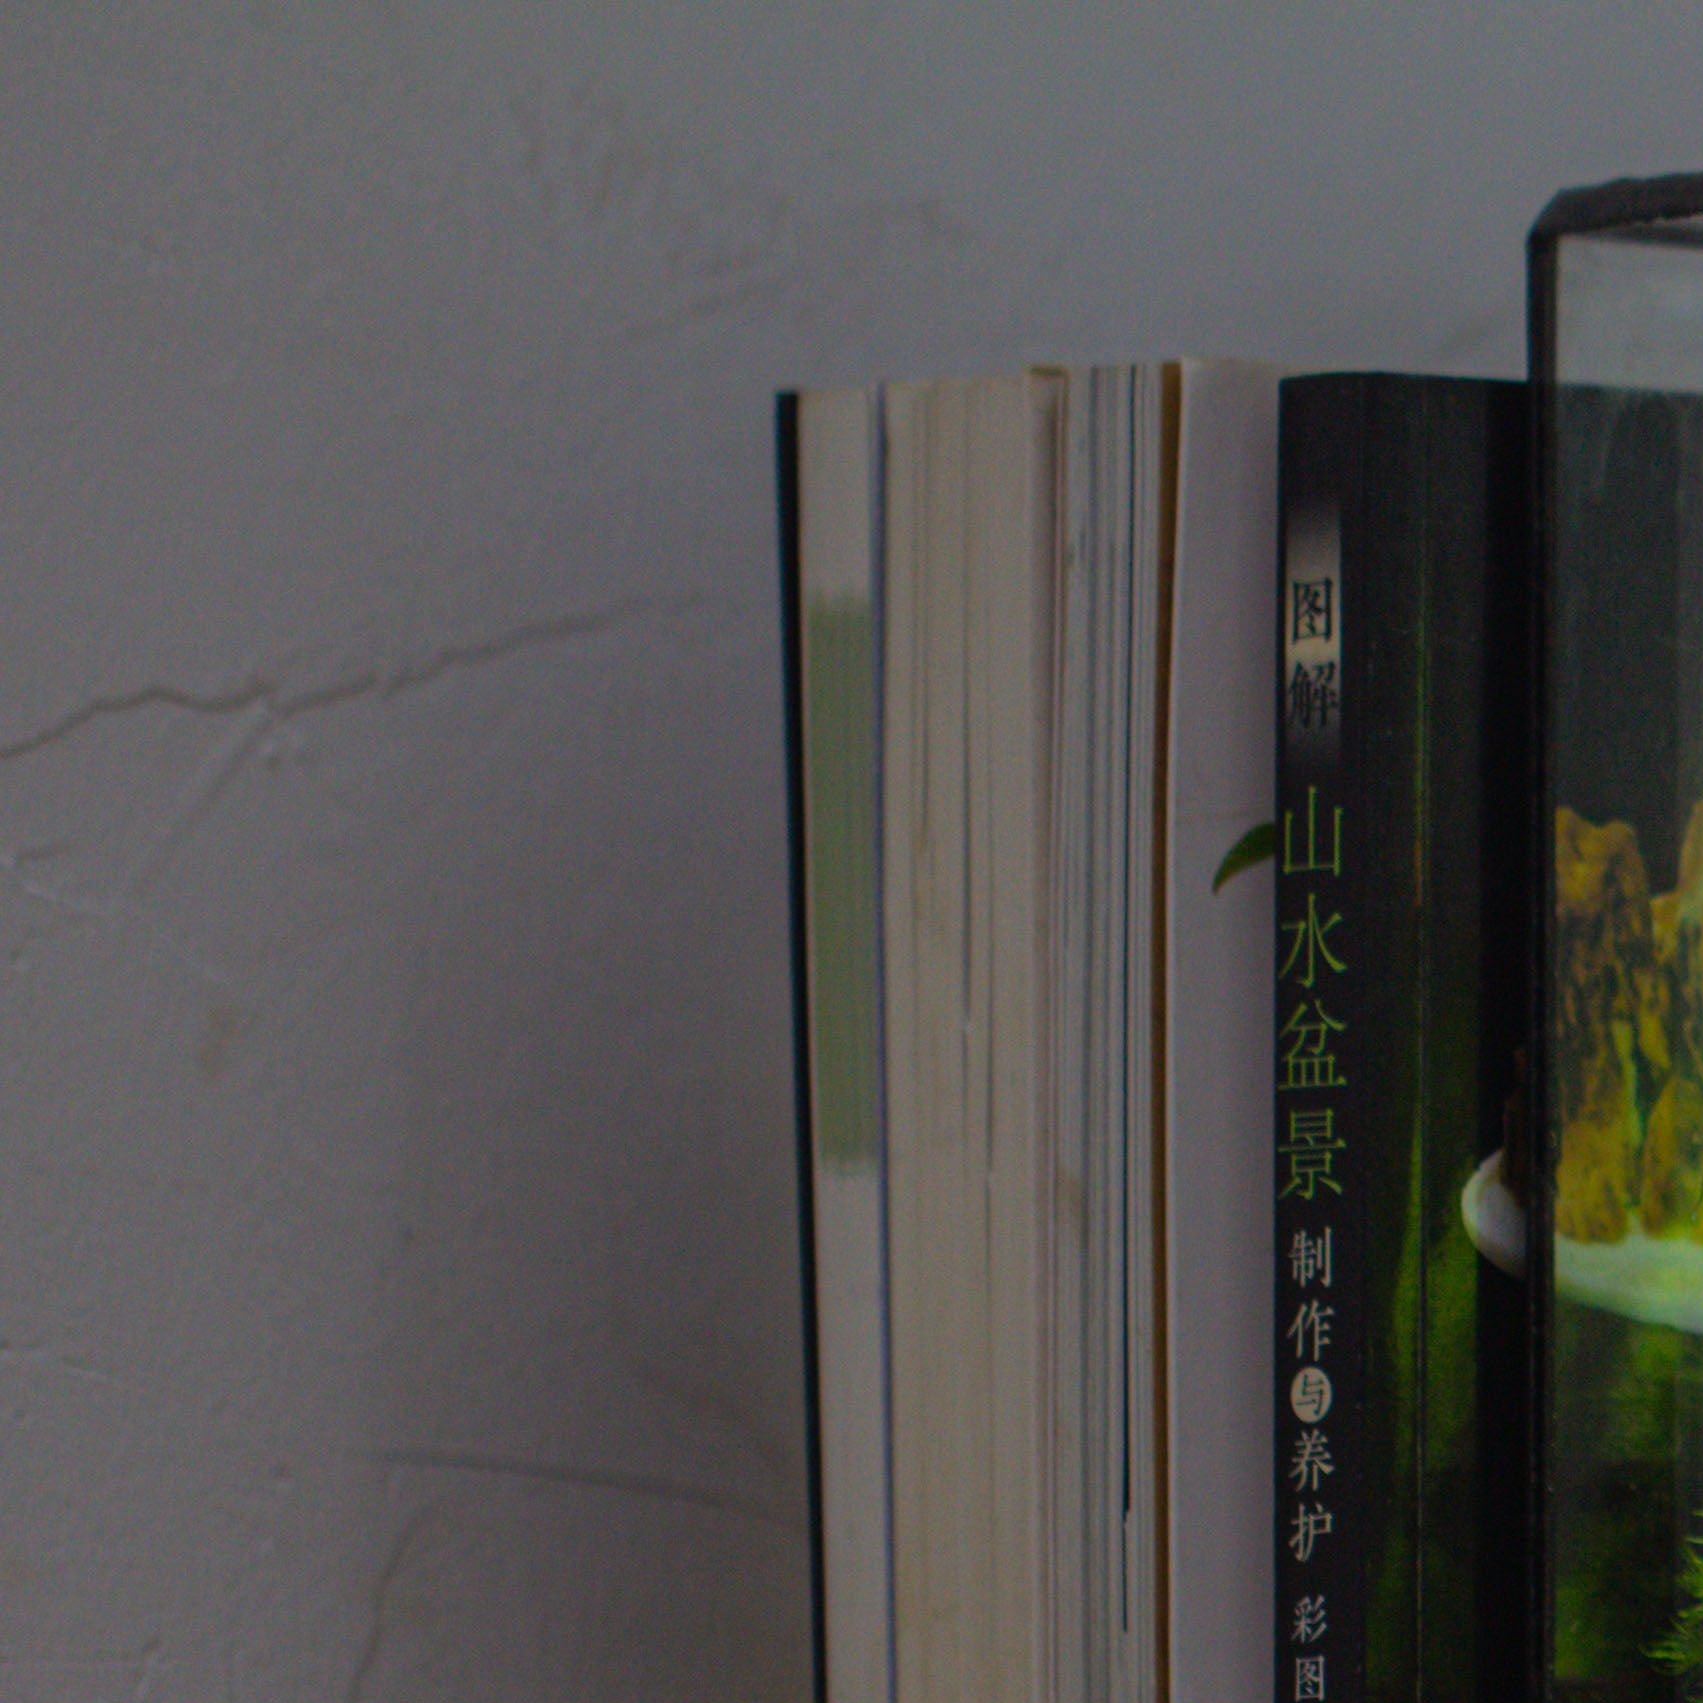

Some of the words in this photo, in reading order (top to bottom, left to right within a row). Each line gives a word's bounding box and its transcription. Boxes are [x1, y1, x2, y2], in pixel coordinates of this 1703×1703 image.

[1288, 576, 1339, 729] 图解
[1277, 785, 1347, 1201] 山水盆景
[1287, 1226, 1336, 1563] 制作与养护
